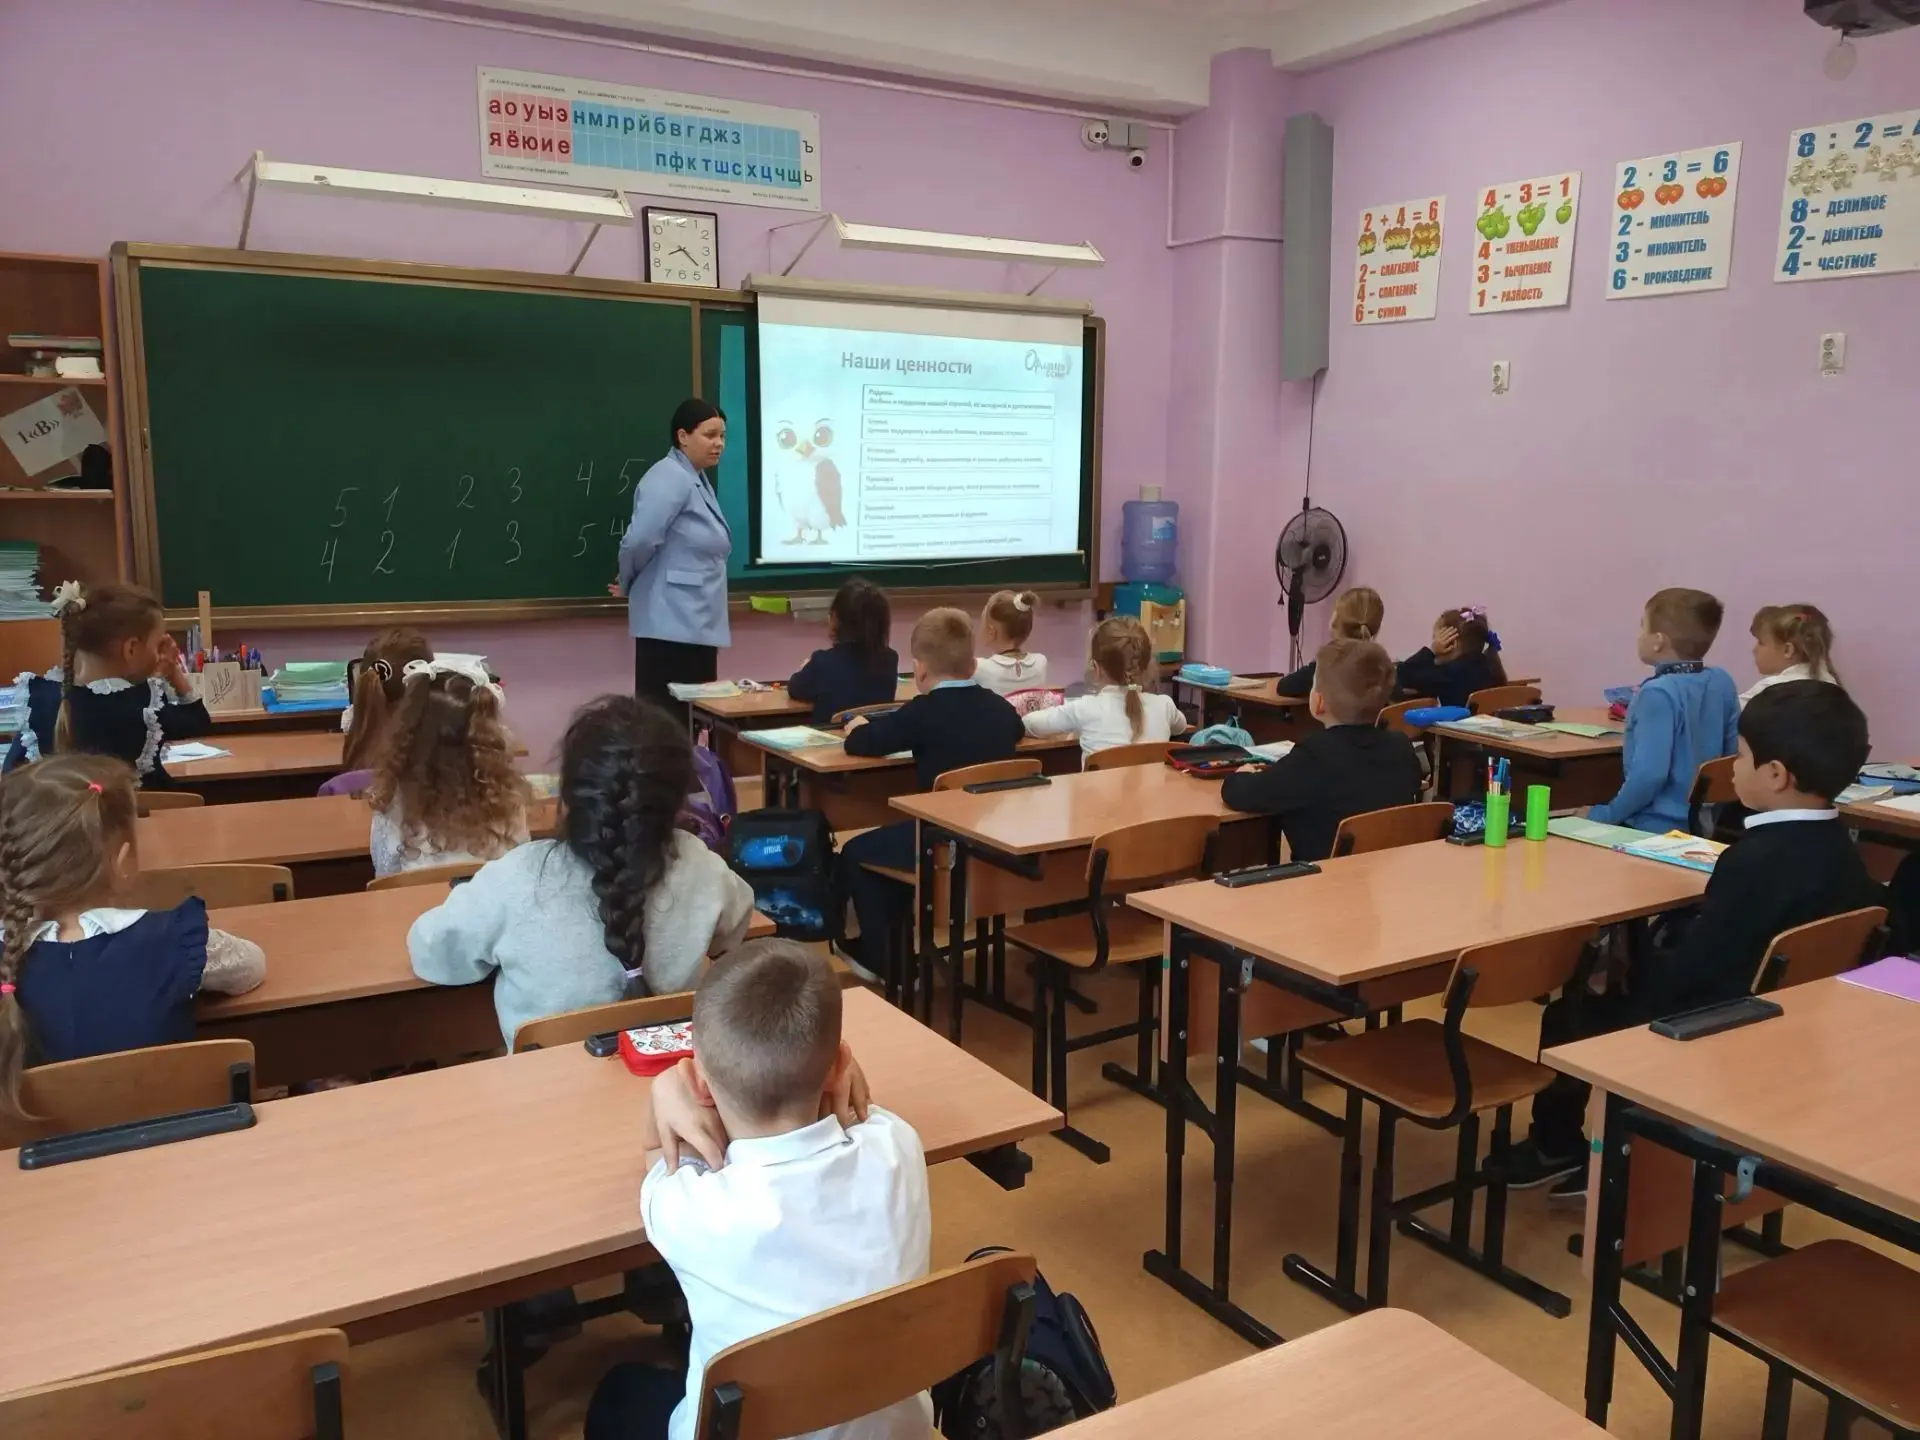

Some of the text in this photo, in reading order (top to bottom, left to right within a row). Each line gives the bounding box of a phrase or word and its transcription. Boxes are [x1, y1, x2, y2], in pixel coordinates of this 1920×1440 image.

[1797, 133, 1816, 157] 8
[1854, 123, 1874, 148] 2
[1623, 167, 1637, 188] 2
[1663, 160, 1677, 182] 3
[1713, 151, 1729, 173] 6
[1484, 190, 1496, 208] 4
[1520, 184, 1532, 203] 3
[1560, 177, 1569, 197] 1
[1364, 213, 1372, 232] 2
[1397, 207, 1405, 226] 4
[1429, 201, 1438, 221] 6
[1790, 199, 1808, 222] 8
[1826, 195, 1887, 217] ДЕЛИМОЕ
[694, 220, 697, 228] 1
[1618, 215, 1632, 236] 2
[1650, 210, 1709, 229] МНОЖИТЕЛЬ
[701, 230, 709, 240] 2
[1786, 225, 1805, 250] 2
[1822, 224, 1883, 245] ДЕЛИТЕЛЬ
[653, 242, 660, 251] 9
[703, 247, 710, 256] 3
[1478, 242, 1490, 260] 4
[1506, 236, 1559, 254] УМЕНЬШАЕМОЕ
[1616, 242, 1630, 262] 3
[1647, 239, 1706, 257] МНОЖИТЕЛЬ
[654, 258, 661, 267] 8
[664, 269, 671, 278] 7
[703, 263, 710, 271] 4
[1359, 264, 1368, 282] 2
[1381, 261, 1420, 276] СЛАГАЕМОЕ
[1478, 265, 1489, 283] 3
[1504, 261, 1552, 277] ВЫЧИТАЕМОЕ
[1782, 252, 1800, 275] 4
[1818, 253, 1877, 270] ЧАСТНОЕ
[679, 270, 686, 280] 6
[693, 271, 701, 280] 5
[1613, 269, 1627, 290] 6
[1644, 267, 1713, 285] ПРОИЗВЕДЕНИЕ
[1357, 284, 1365, 302] 4
[1379, 284, 1417, 298] СЛАГАЕМОЕ
[1477, 289, 1486, 307] 1
[1501, 288, 1543, 302] РАЗНОСТЬ
[1356, 304, 1364, 322] 6
[1378, 306, 1406, 318] СУММА
[842, 351, 972, 375] Наши ценности
[330, 459, 646, 527] 5 1 2 3 4 5
[320, 537, 338, 584] 4
[372, 530, 394, 575] 2
[446, 529, 461, 569] 1
[505, 521, 522, 564] 3
[573, 523, 598, 558] 5
